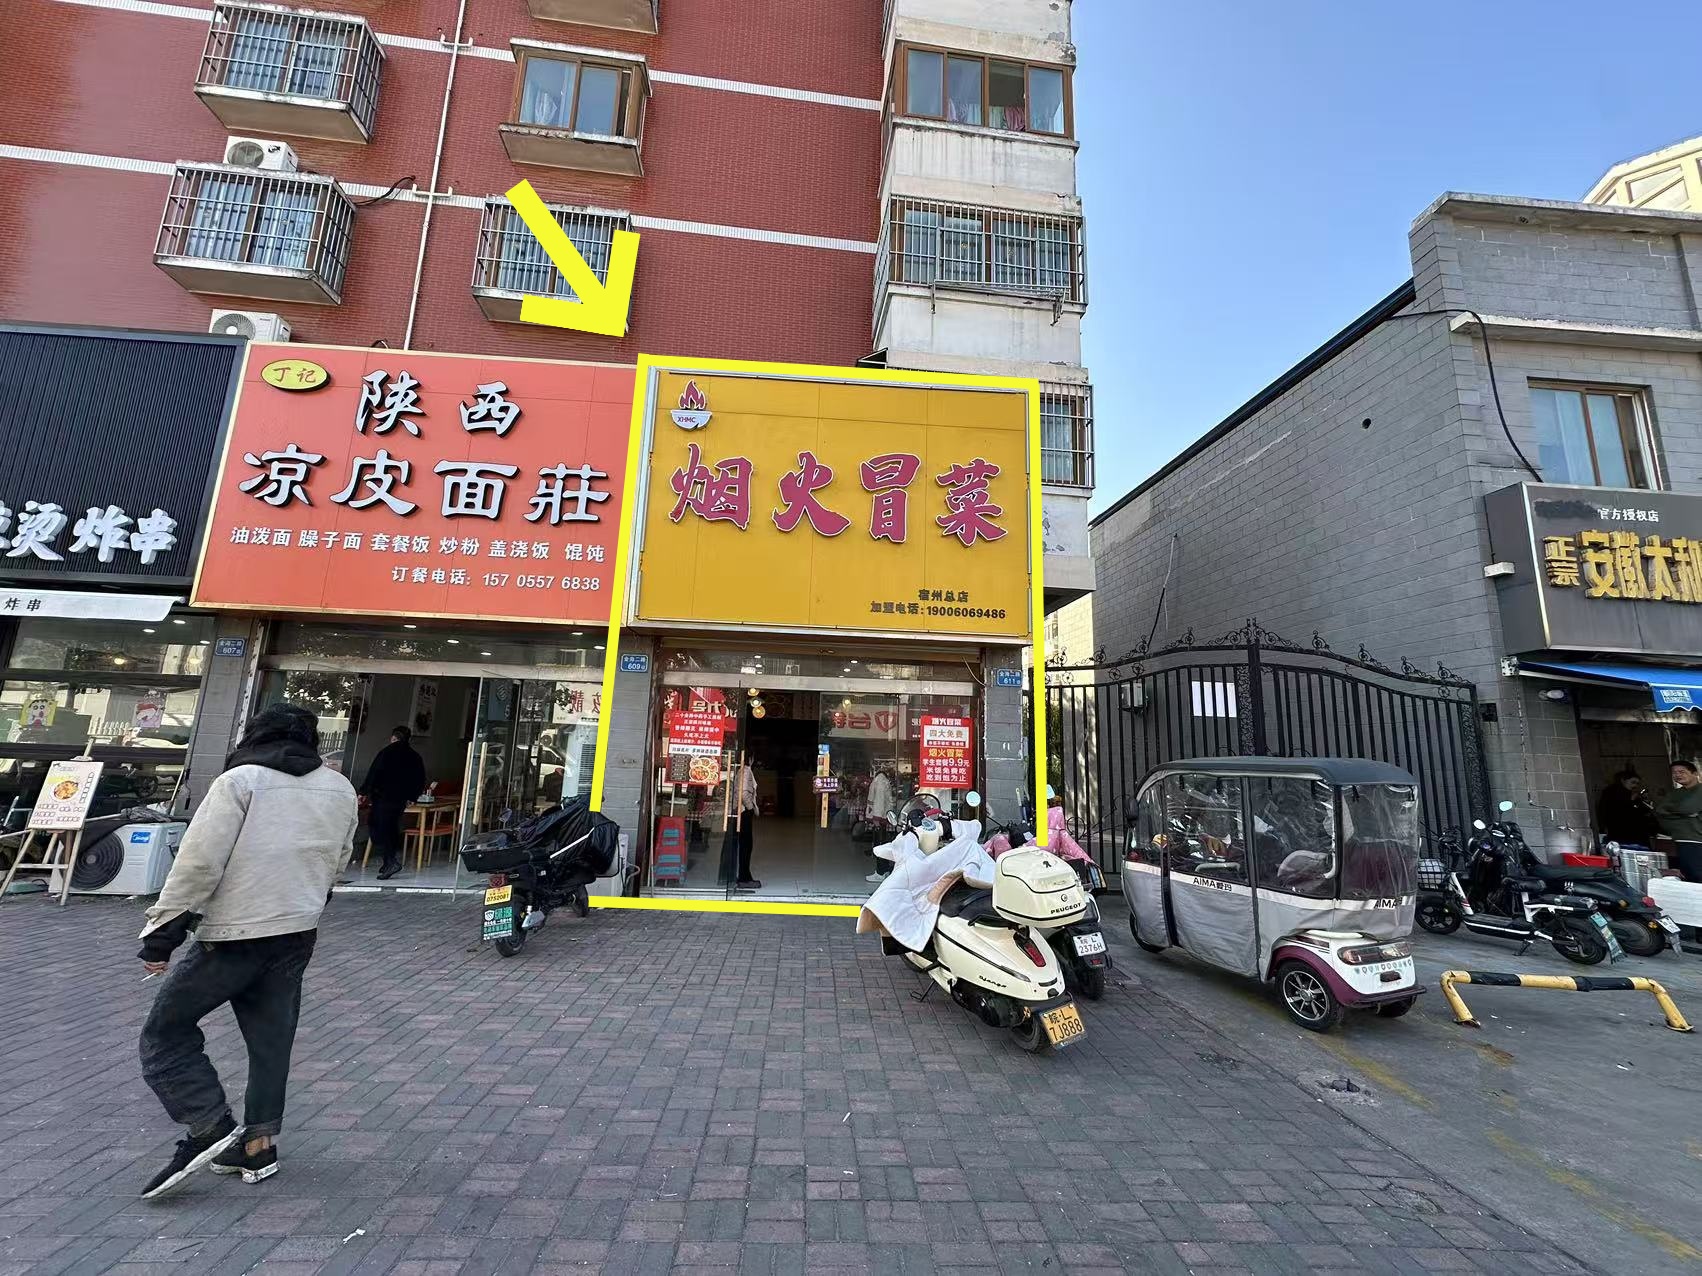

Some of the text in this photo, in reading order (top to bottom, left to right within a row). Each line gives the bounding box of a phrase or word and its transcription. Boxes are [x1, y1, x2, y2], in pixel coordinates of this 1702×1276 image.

[272, 367, 317, 384] 丁记
[669, 442, 1008, 547] 烟火冒菜
[230, 526, 605, 563] 油泼面 臊子面 套餐饭 炒粉 盖浇饭 馄饨
[482, 573, 510, 587] 157
[516, 574, 555, 589] 0557
[561, 576, 601, 591] 6838
[919, 589, 969, 603] 宿州总店
[4, 598, 42, 612] 炸串
[1050, 902, 1082, 915] PEUGEOT
[1078, 941, 1103, 954] 2376H
[1049, 1018, 1083, 1041] 7J888
